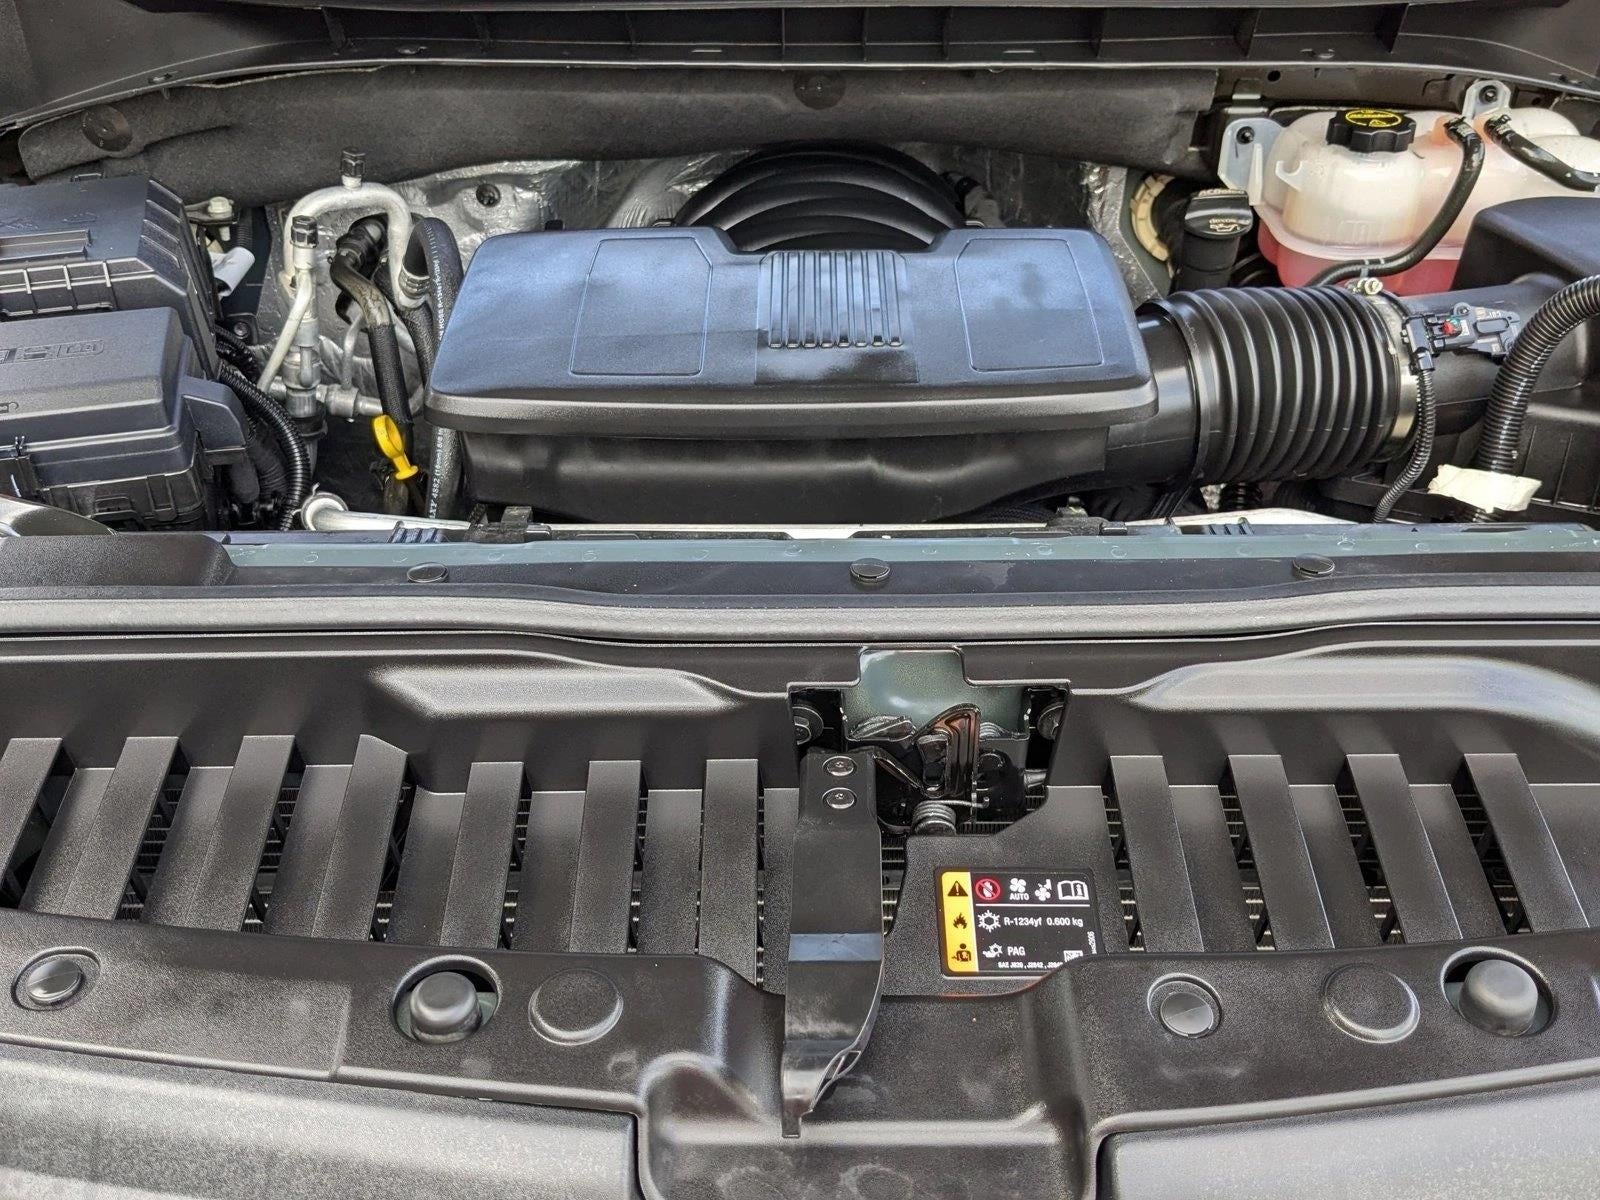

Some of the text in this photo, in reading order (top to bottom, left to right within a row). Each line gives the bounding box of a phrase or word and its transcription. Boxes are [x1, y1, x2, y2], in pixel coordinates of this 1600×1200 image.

[1009, 892, 1030, 901] AUTO
[1003, 916, 1084, 927] R-1234yf 0.600 kg
[1007, 946, 1026, 956] PAG
